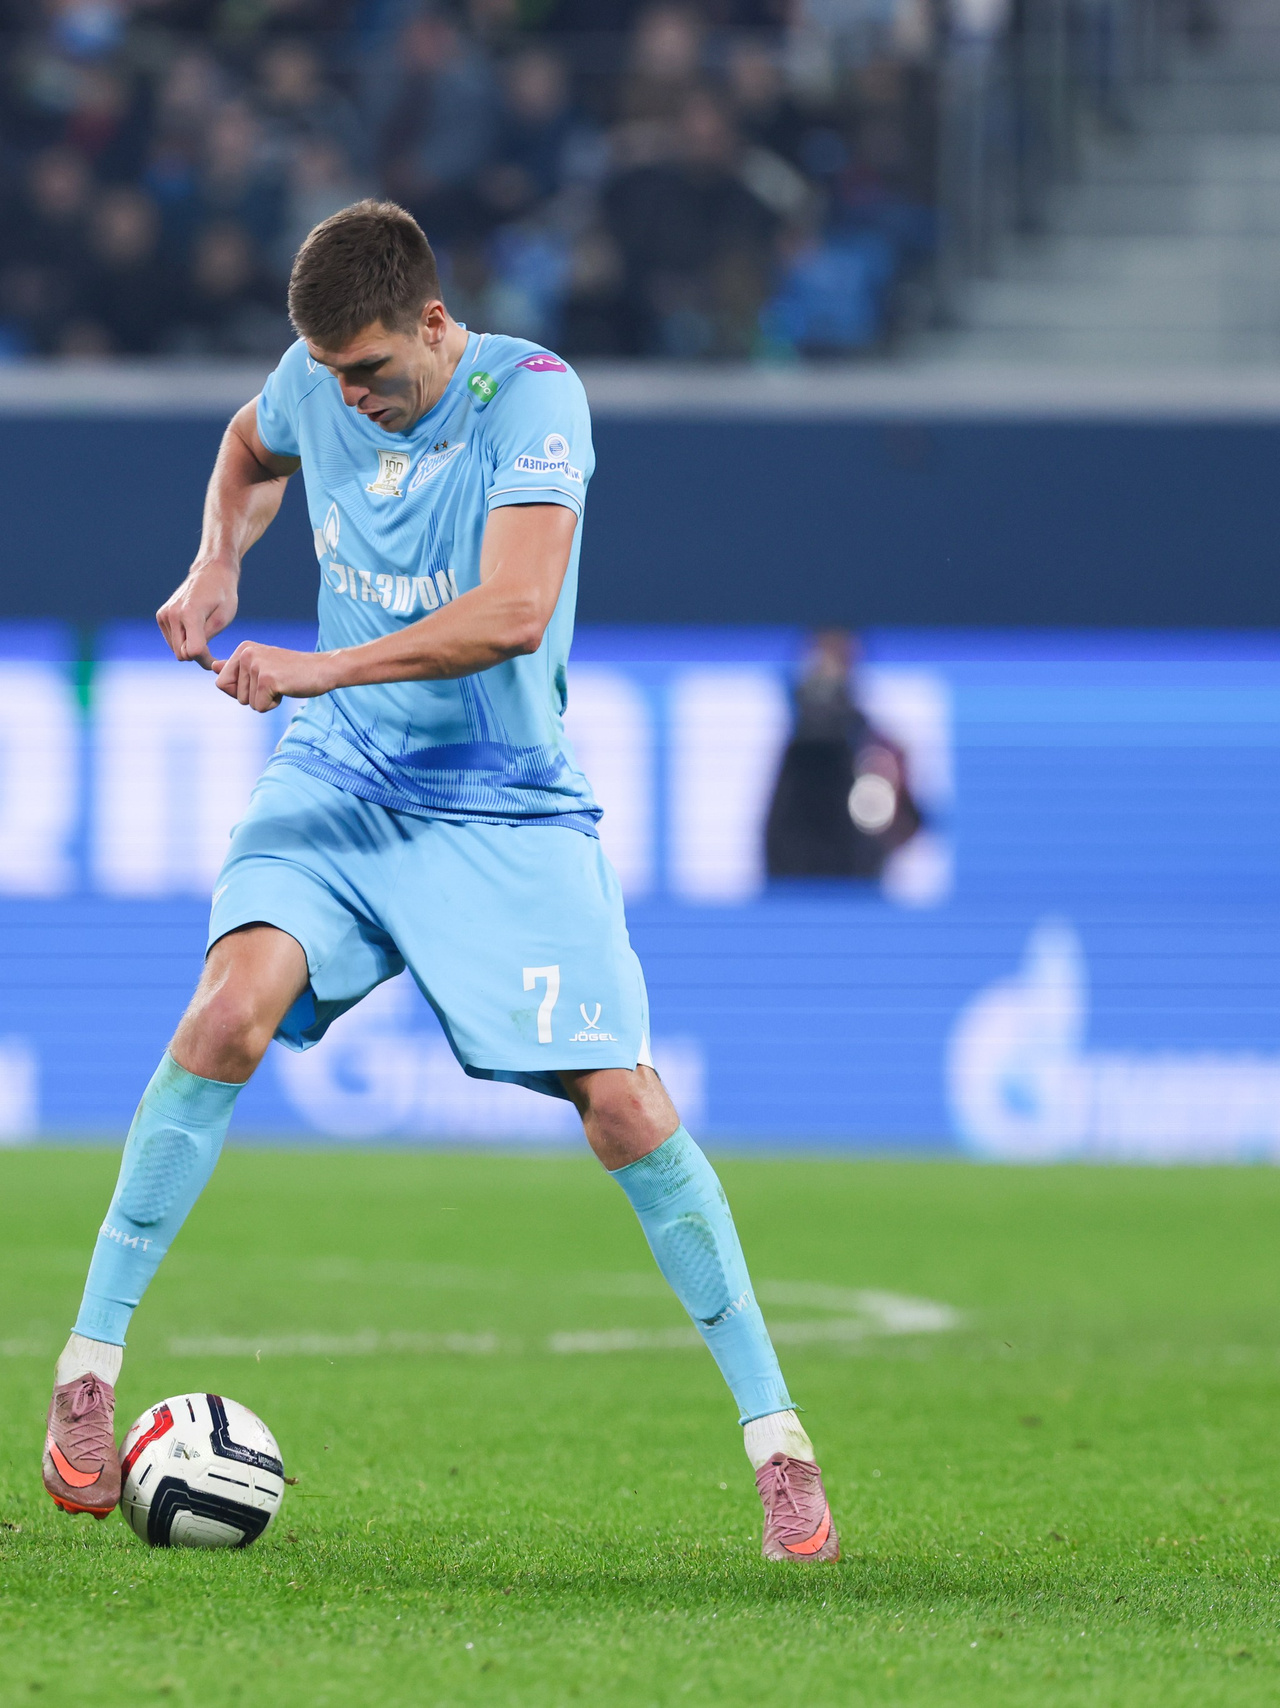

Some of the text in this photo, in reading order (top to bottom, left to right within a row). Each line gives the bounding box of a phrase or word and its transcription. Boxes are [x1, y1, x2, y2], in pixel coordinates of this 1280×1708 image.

[522, 964, 560, 1044] 7
[568, 1031, 619, 1042] JÖGEL
[100, 1222, 153, 1252] ЕНИТ
